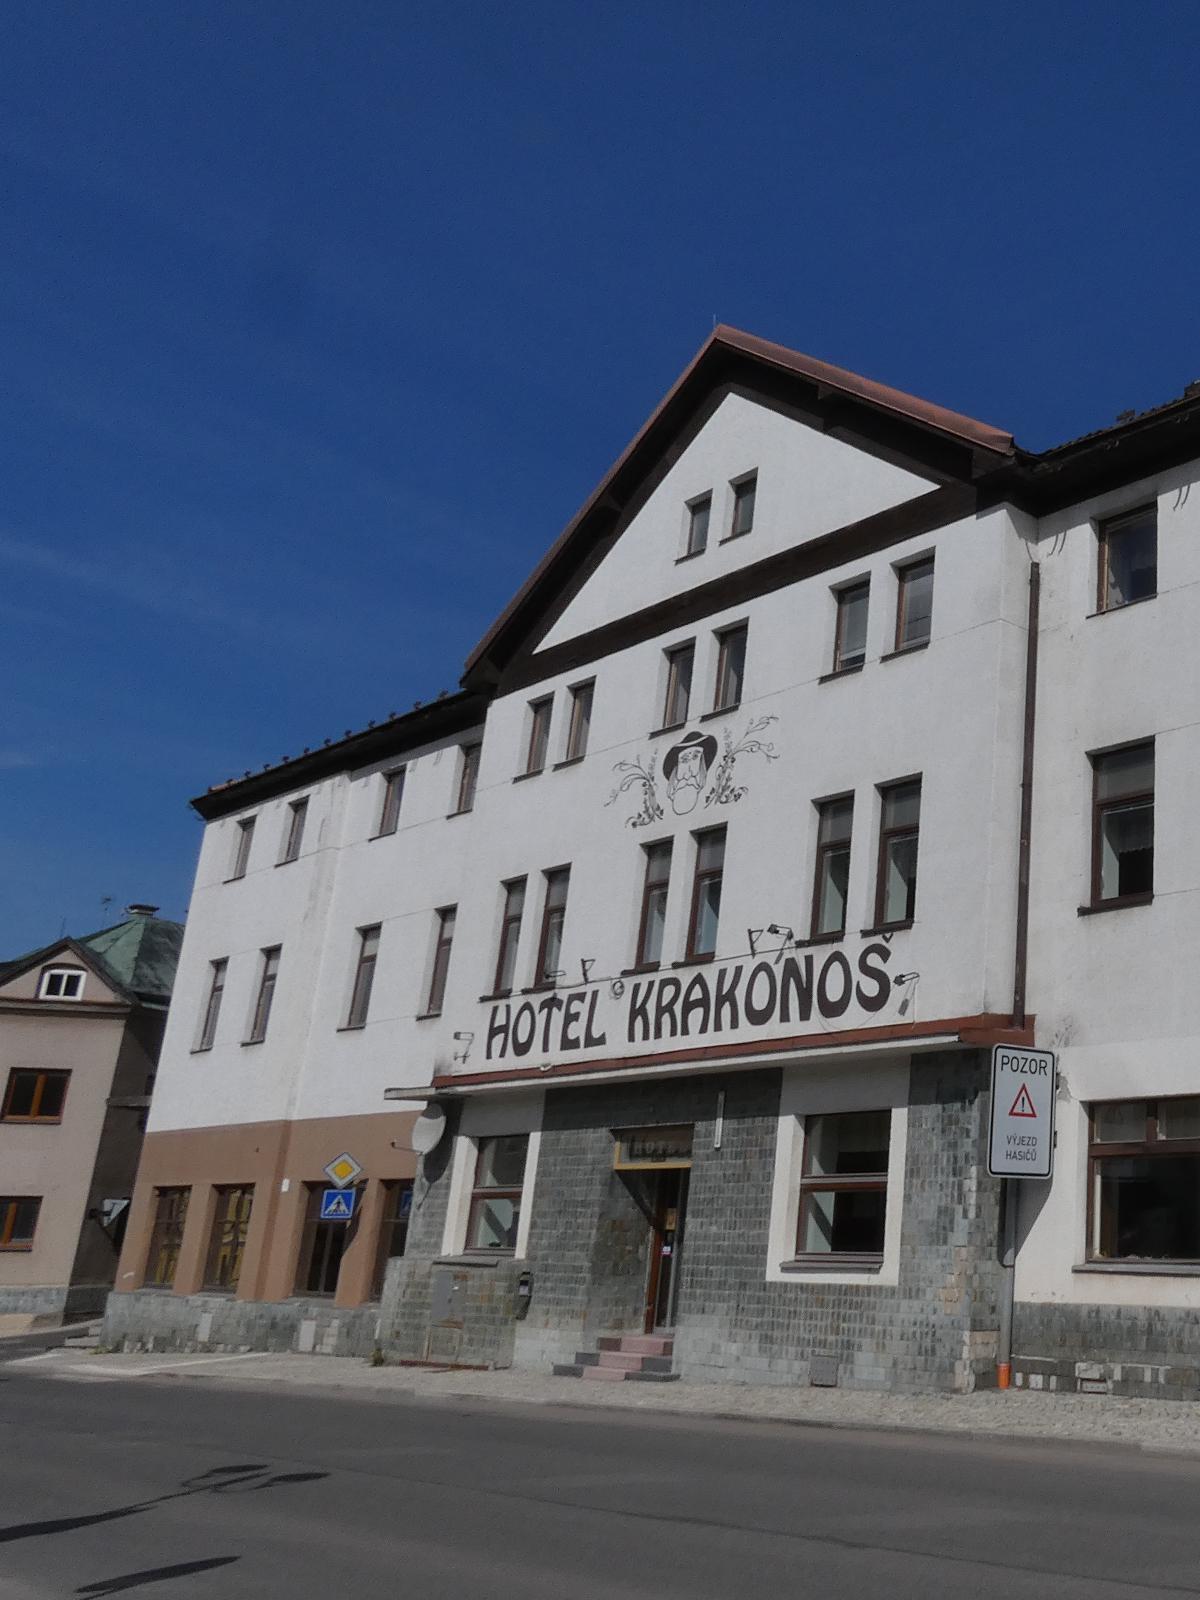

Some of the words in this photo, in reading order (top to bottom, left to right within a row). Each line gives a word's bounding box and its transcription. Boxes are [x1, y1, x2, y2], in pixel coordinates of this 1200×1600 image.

[485, 989, 607, 1060] HOTEL
[627, 932, 892, 1043] KRAKONOŠ
[1000, 1055, 1048, 1076] POZOR
[1006, 1132, 1038, 1147] VÝJEZD
